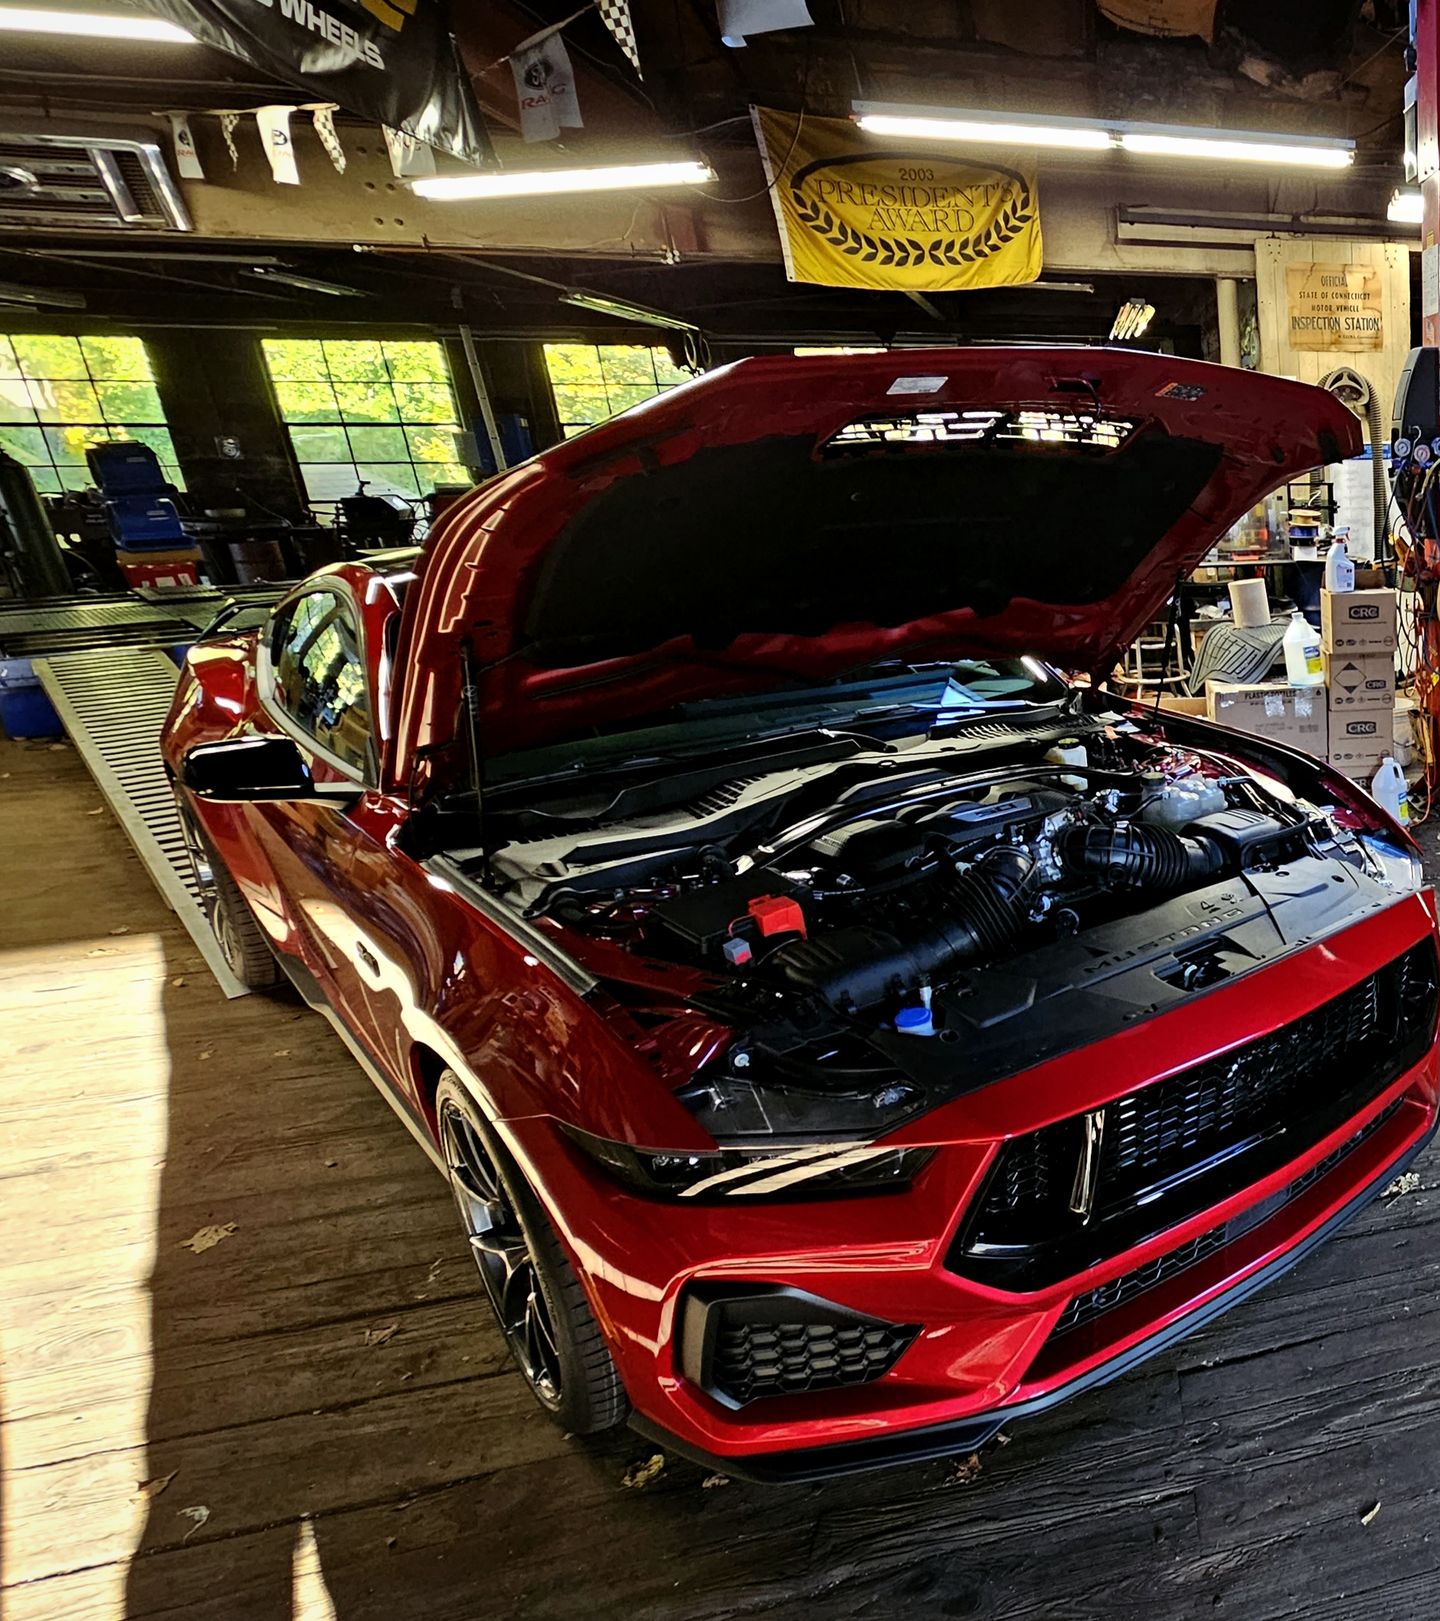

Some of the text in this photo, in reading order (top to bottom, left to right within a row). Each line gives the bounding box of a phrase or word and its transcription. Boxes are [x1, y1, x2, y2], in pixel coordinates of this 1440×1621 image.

[280, 0, 385, 70] WHEELS
[899, 168, 934, 181] 2003
[815, 179, 1014, 208] PRESIDENT'S
[867, 207, 975, 233] AWARD
[1332, 292, 1370, 300] CONNECTICUT
[1292, 316, 1379, 331] INSPECTION STATION
[1351, 607, 1378, 617] CRC
[1348, 723, 1375, 733] CRC
[1083, 907, 1244, 974] MUSTANG
